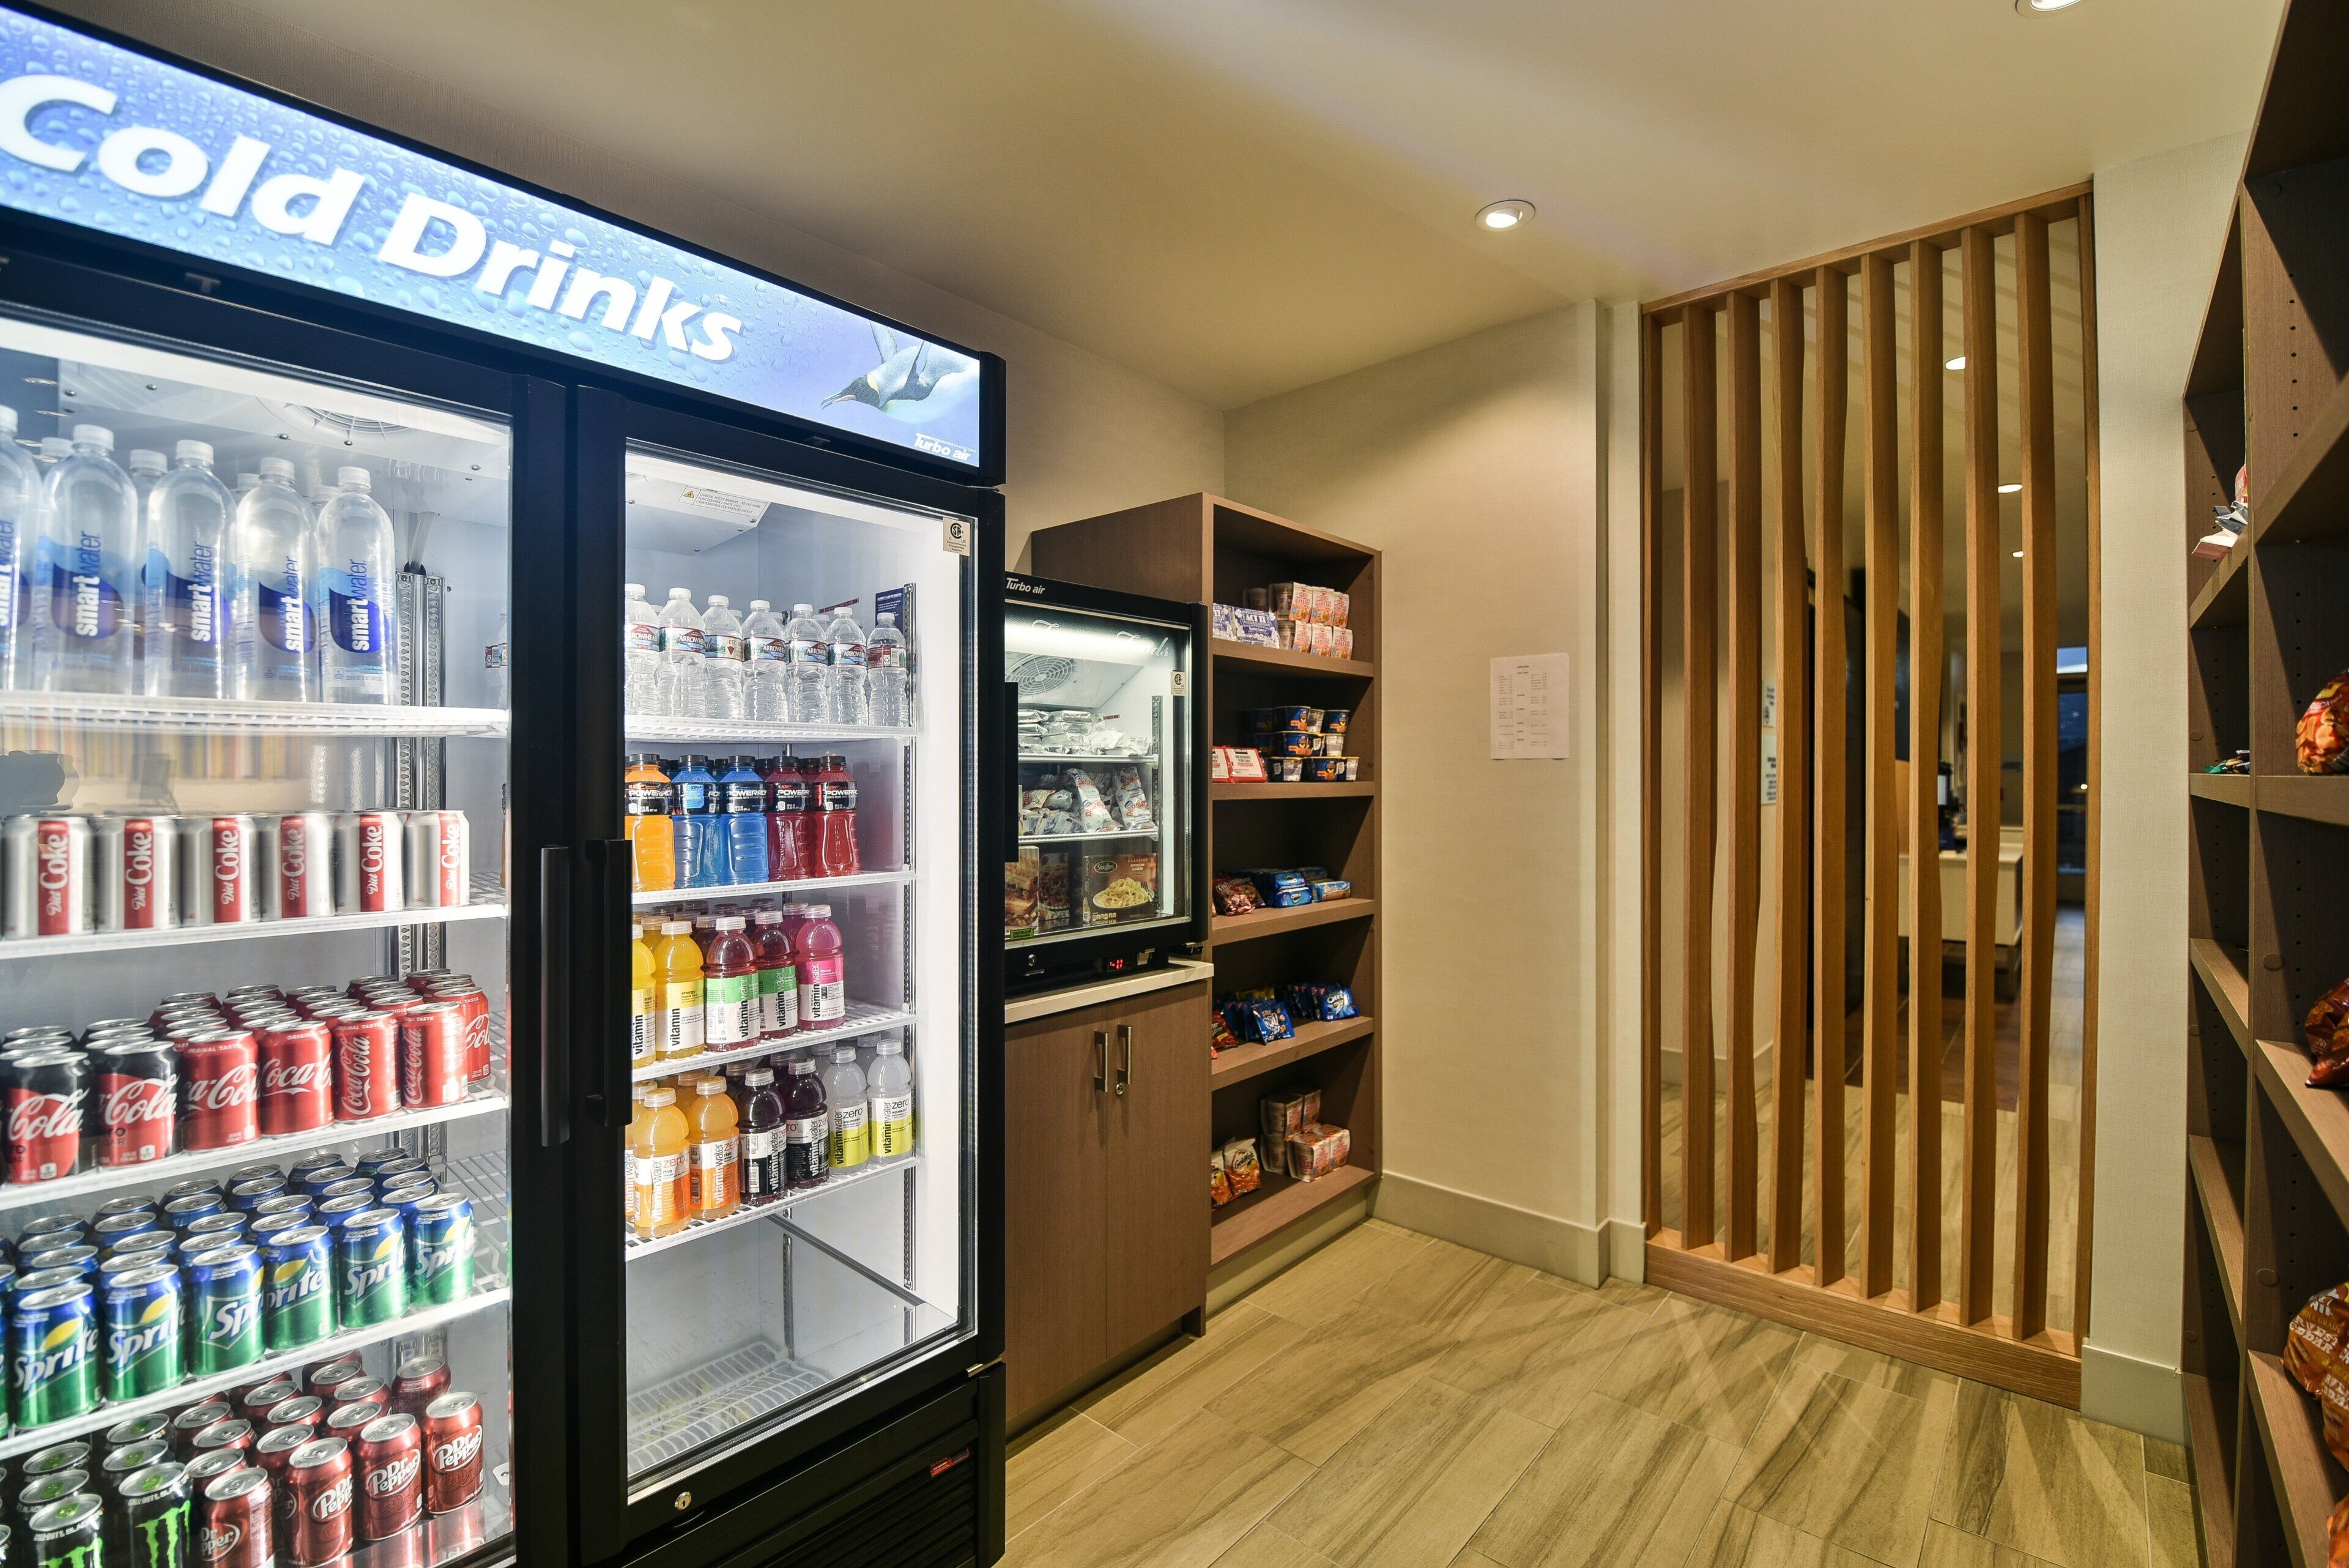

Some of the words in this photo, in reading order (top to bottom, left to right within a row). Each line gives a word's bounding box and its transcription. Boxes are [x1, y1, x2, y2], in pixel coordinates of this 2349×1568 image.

[0, 75, 363, 245] Cold
[378, 191, 744, 364] Drinks
[914, 433, 951, 456] Turbo
[952, 449, 971, 461] air
[1006, 577, 1031, 592] Turbo
[1033, 585, 1045, 595] air
[1245, 614, 1260, 623] ACT
[125, 830, 153, 885] Coke
[215, 829, 240, 881] Coke
[281, 827, 306, 877] Coke
[362, 825, 384, 873] Coke
[440, 823, 460, 869] Coke
[40, 833, 69, 890] Coke
[132, 886, 147, 910] Diet
[221, 881, 235, 905] Diet
[288, 878, 300, 901] Diet
[340, 1035, 371, 1115] Coca-Cola
[843, 1107, 863, 1119] zero
[892, 1098, 910, 1109] zero
[663, 1156, 686, 1169] zero
[265, 1264, 325, 1309] prite
[2296, 1315, 2339, 1347] RVEST
[2318, 1315, 2342, 1334] GRAIN
[434, 1432, 482, 1469] Pepper
[458, 1431, 473, 1451] Dr
[371, 1455, 418, 1495] Pepper
[387, 1455, 409, 1475] Dr
[336, 1473, 352, 1492] Dr
